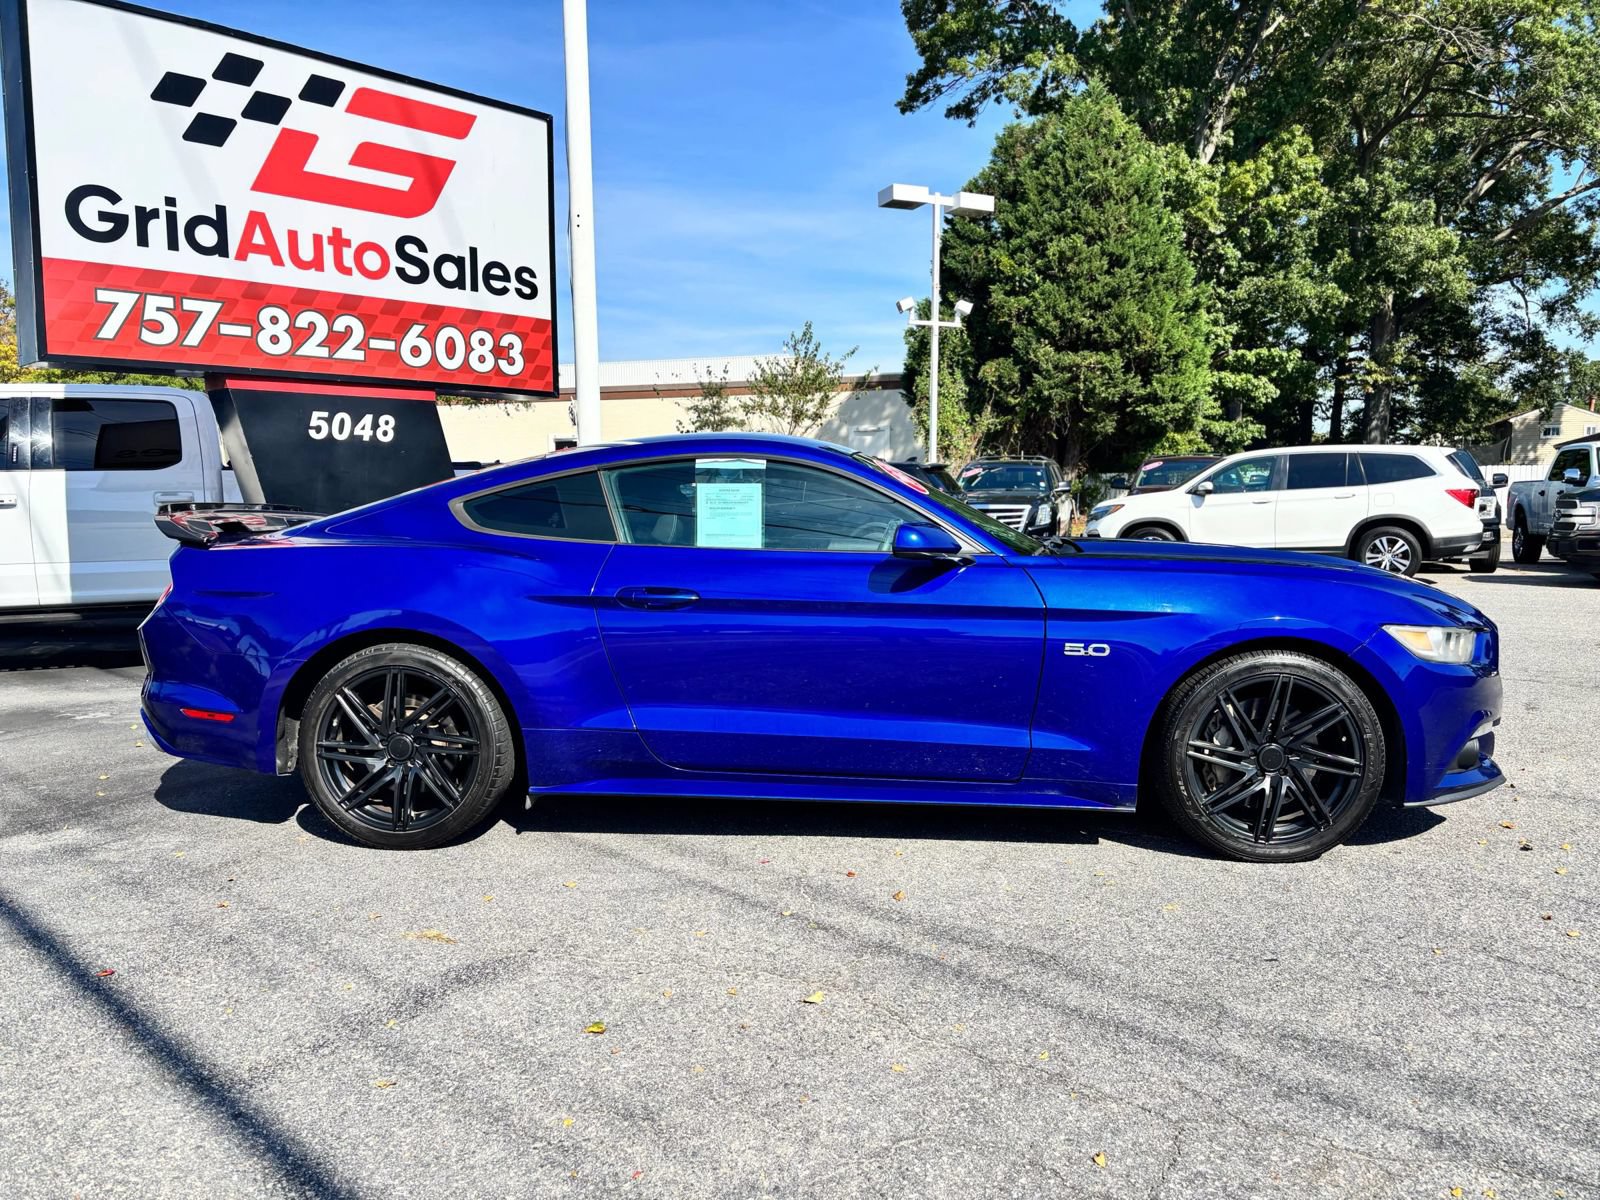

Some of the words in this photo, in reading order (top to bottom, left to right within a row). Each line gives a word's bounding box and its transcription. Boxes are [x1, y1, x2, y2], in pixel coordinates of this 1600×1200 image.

[94, 287, 525, 376] 757-822-6083
[308, 411, 395, 442] 5048
[1064, 642, 1111, 657] 5.0
